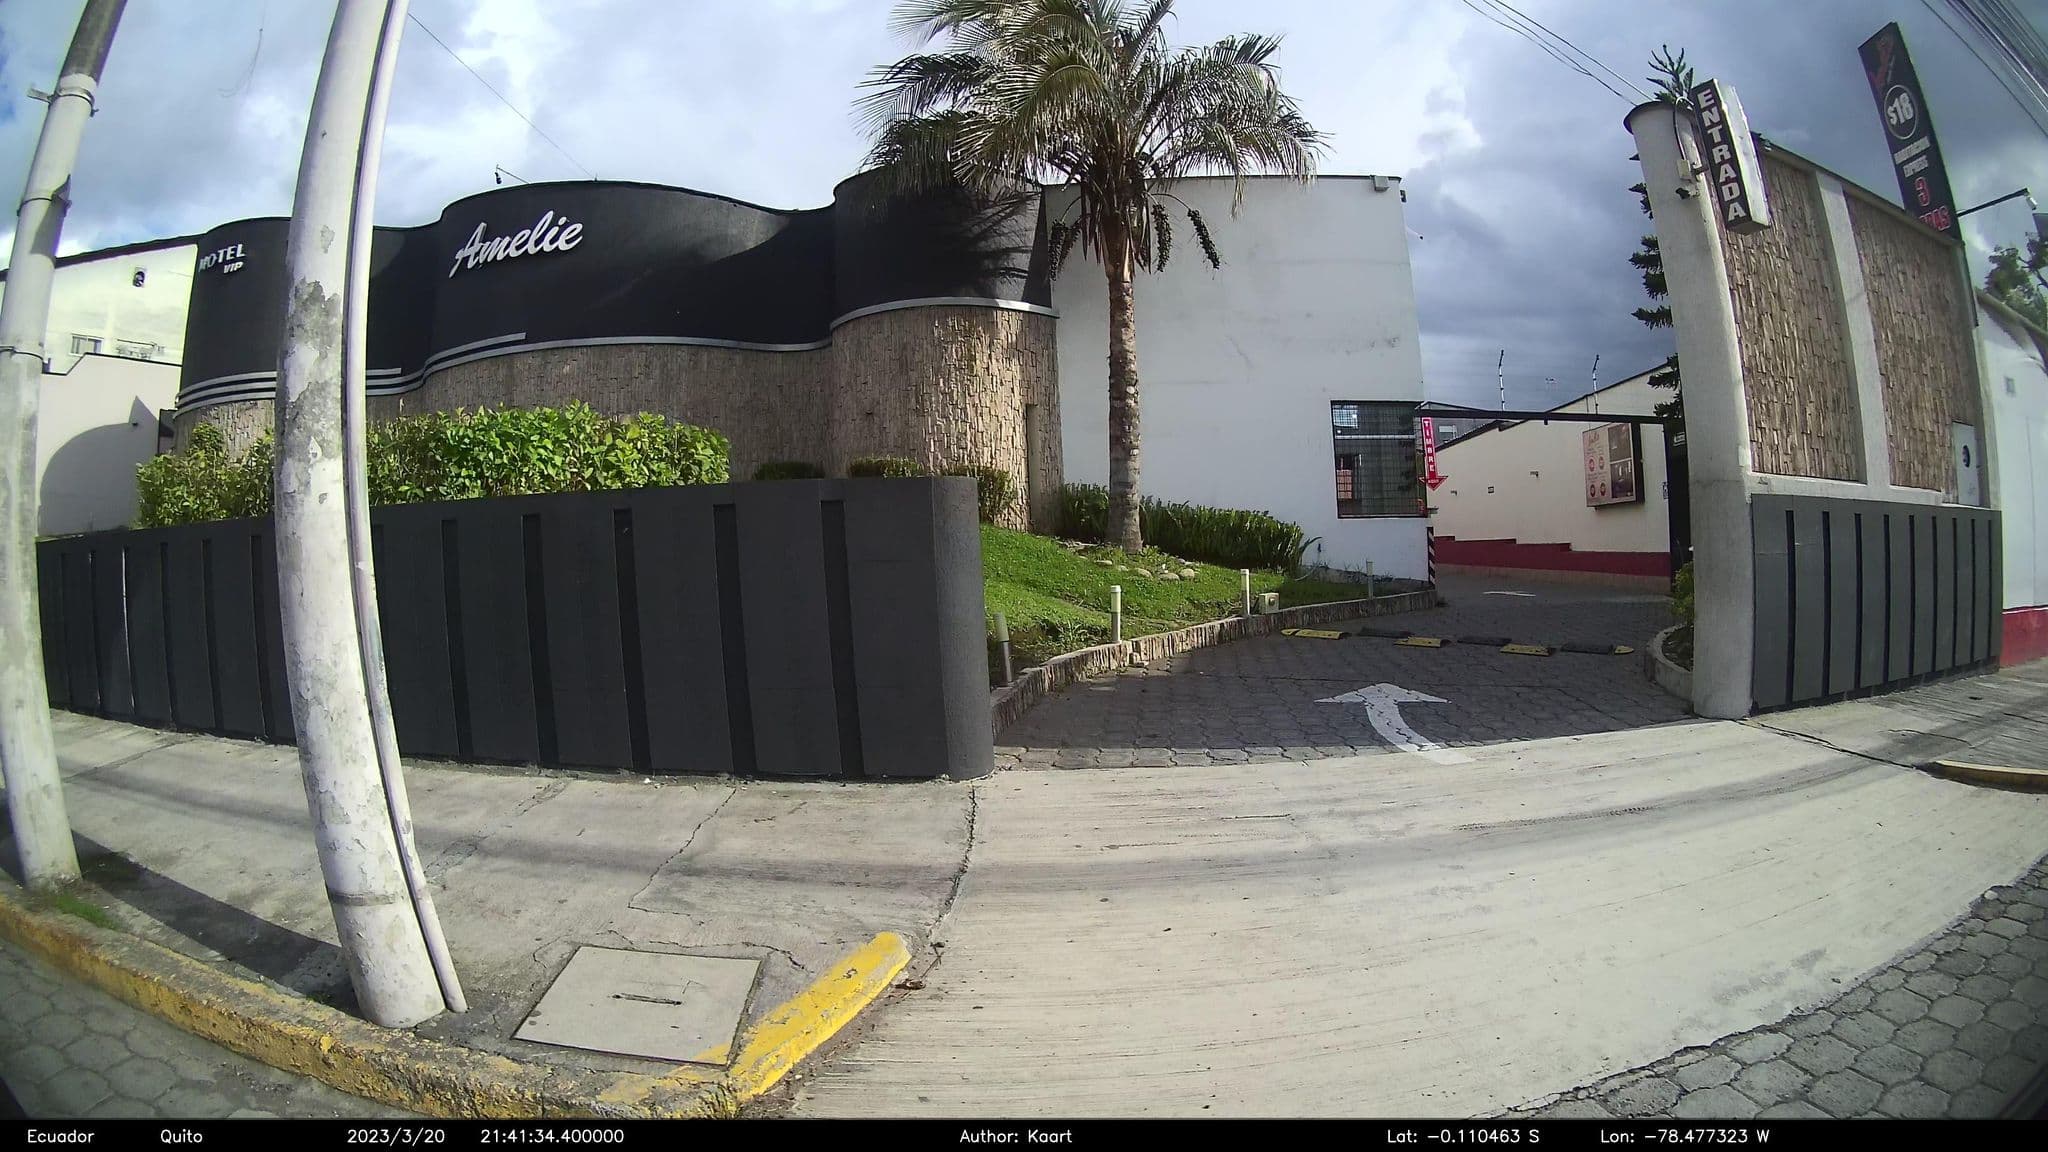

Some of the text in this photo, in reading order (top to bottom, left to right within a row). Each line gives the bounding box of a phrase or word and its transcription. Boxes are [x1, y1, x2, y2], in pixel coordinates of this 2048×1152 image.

[1697, 88, 1747, 222] ENTRADA
[223, 261, 244, 274] VIP
[448, 210, 583, 278] Amelie
[1423, 420, 1436, 472] TIMBRE
